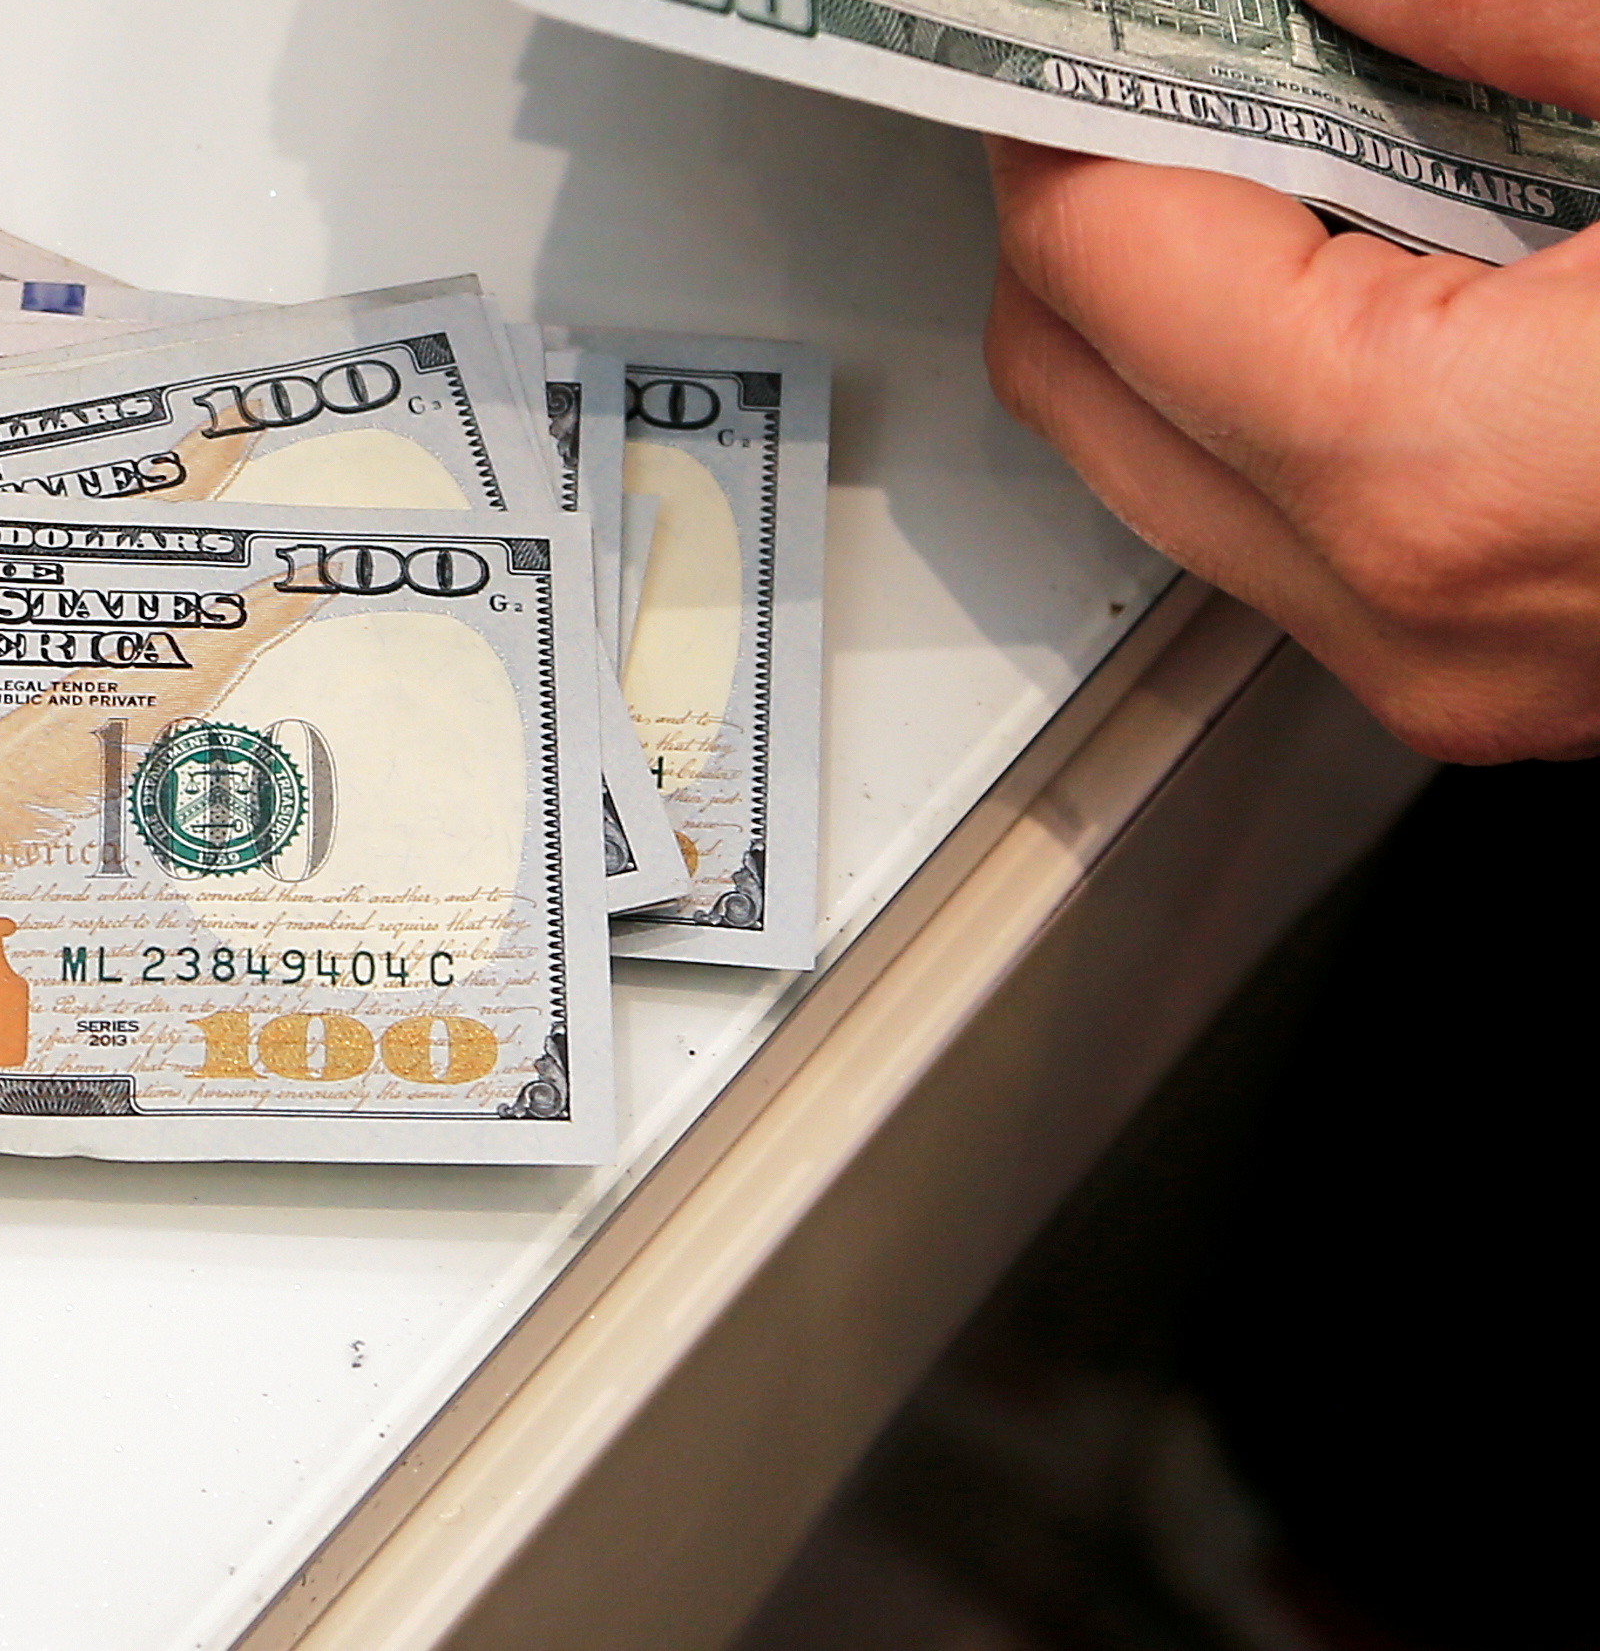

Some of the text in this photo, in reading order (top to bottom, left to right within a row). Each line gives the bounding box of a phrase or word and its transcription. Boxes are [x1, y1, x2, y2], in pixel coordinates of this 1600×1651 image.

[1346, 100, 1390, 124] HALL
[1042, 56, 1558, 220] ONE HUNDRED DOLLARS
[193, 359, 401, 439] 100
[273, 544, 490, 597] 100
[489, 593, 509, 613] G
[48, 694, 84, 707] AND
[89, 694, 158, 708] PRIVATE
[50, 681, 119, 694] TENDER
[217, 734, 245, 747] OF
[268, 769, 296, 844] TREASURY
[61, 946, 124, 984] ML
[141, 946, 410, 989] 23849404
[430, 949, 456, 988] C
[76, 1020, 140, 1034] SERIES
[88, 1034, 128, 1047] 2013
[184, 1010, 500, 1086] 100
